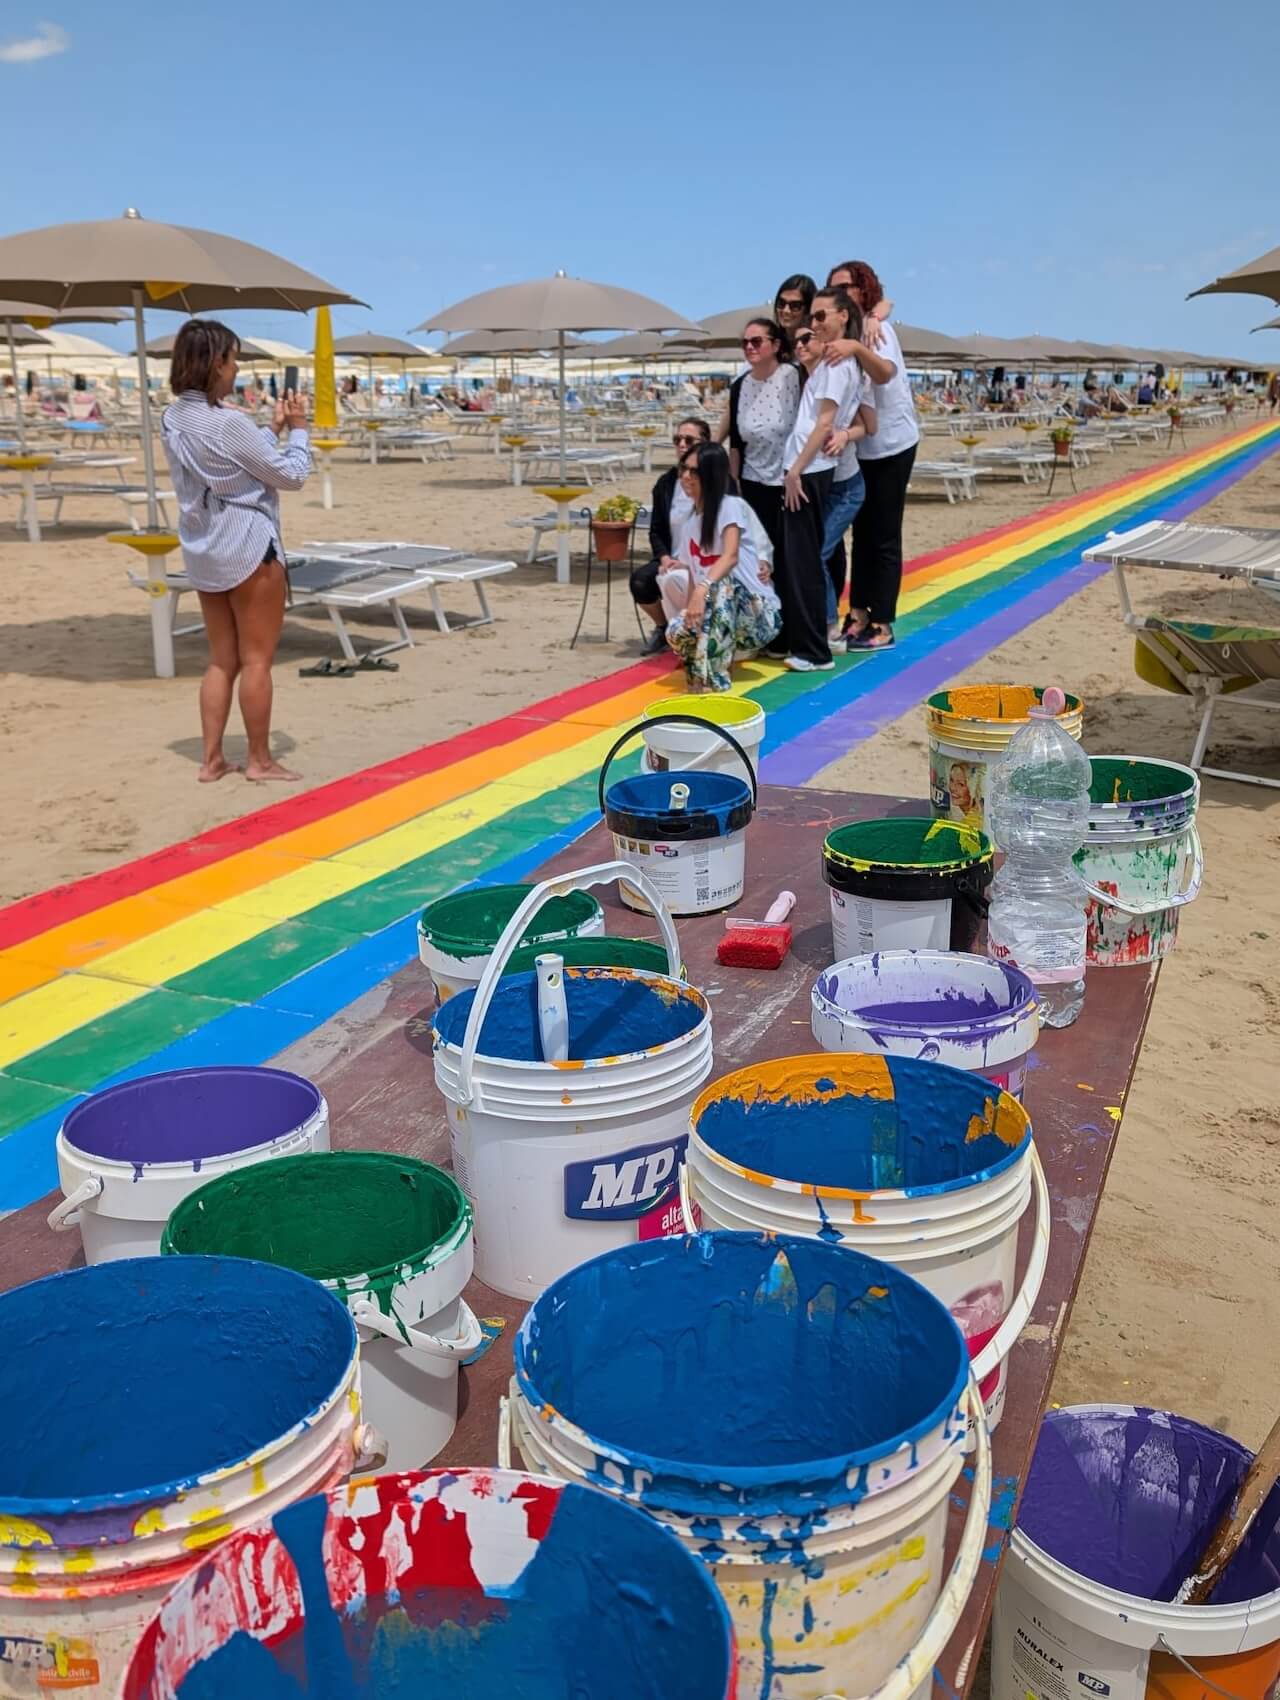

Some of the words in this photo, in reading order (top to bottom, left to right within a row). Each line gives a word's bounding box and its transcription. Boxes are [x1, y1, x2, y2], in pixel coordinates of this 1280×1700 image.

[580, 1146, 675, 1210] MP
[1016, 1627, 1064, 1672] MURALEX
[1081, 1675, 1106, 1692] MP
